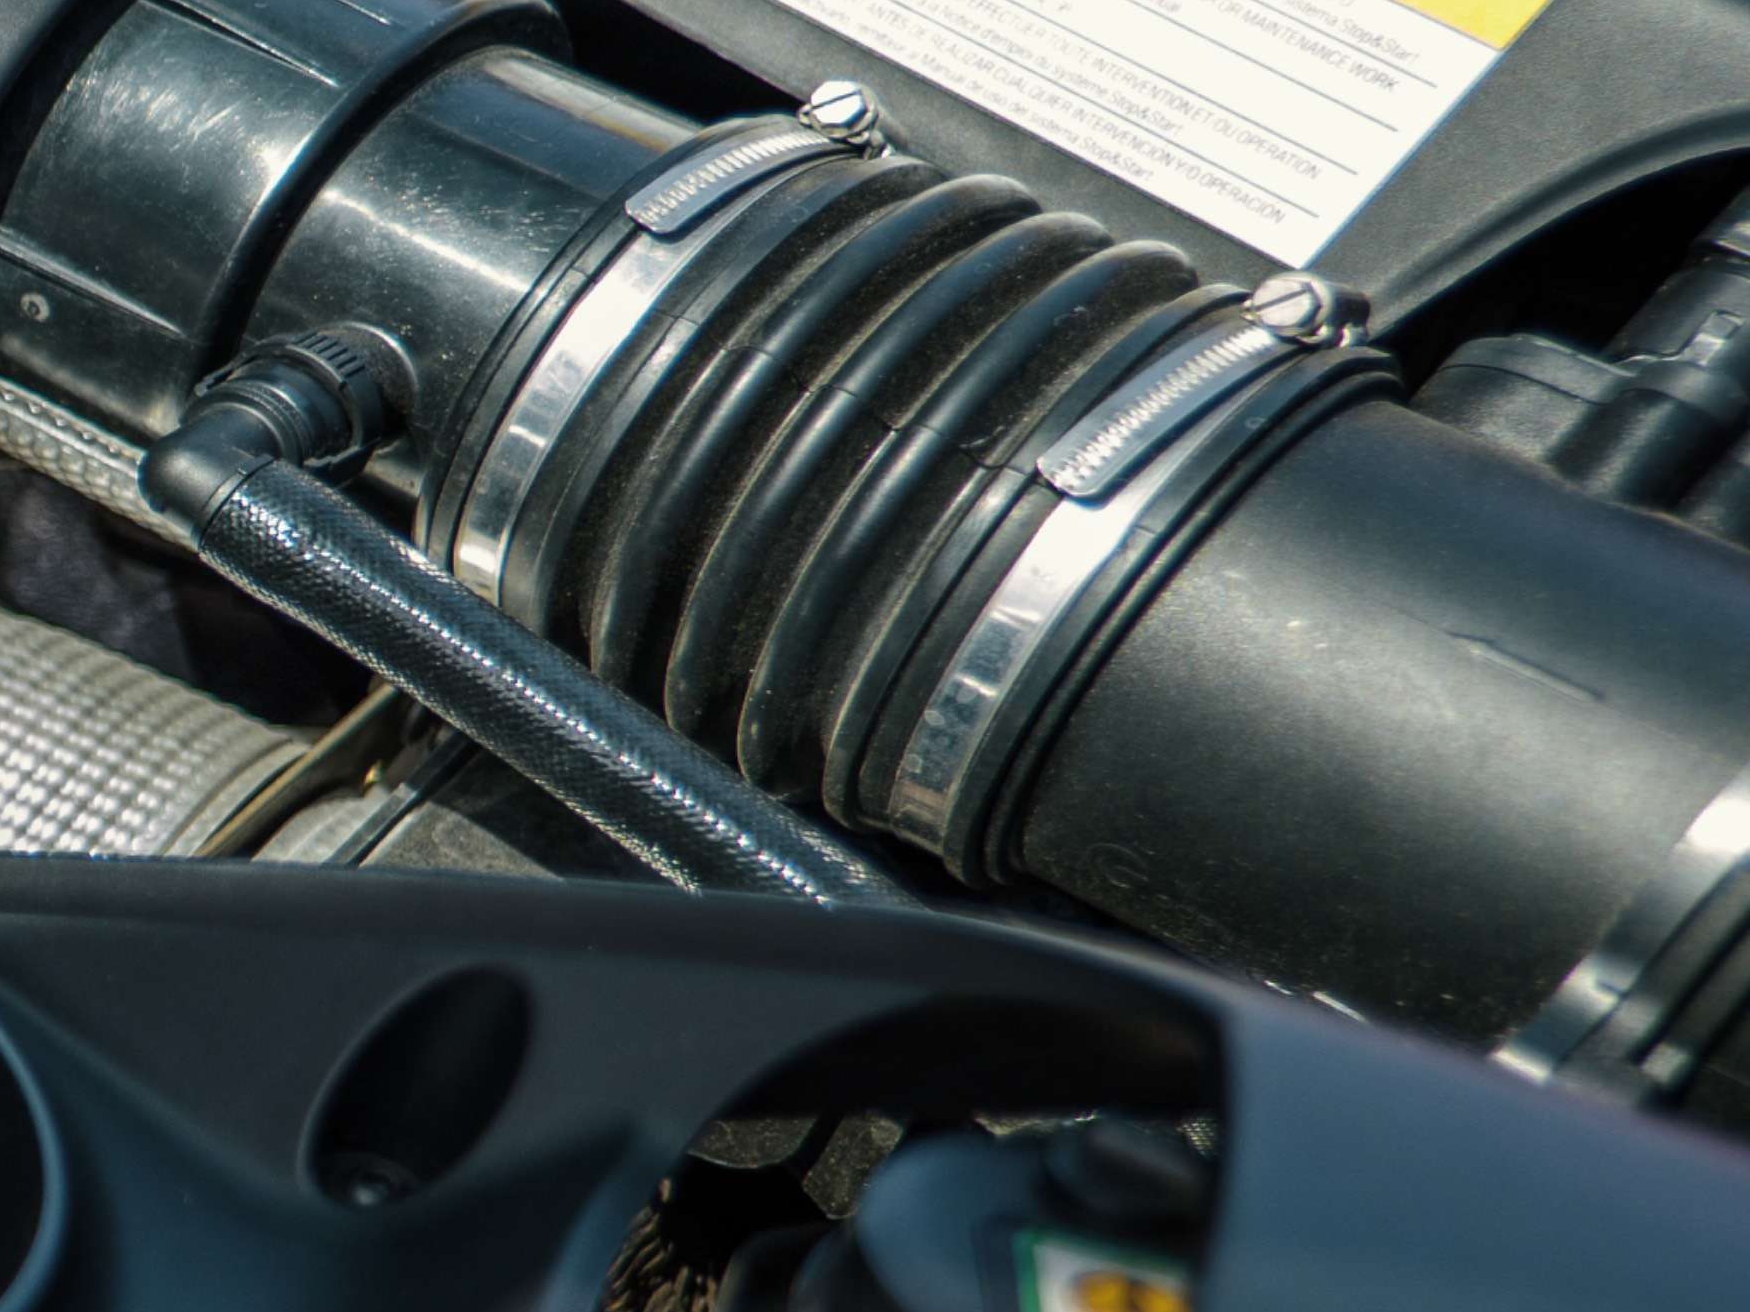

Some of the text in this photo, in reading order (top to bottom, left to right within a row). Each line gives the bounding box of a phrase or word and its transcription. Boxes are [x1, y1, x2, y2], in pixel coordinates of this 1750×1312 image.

[1238, 7, 1353, 69] MAINTENANCE
[1335, 17, 1423, 66] Stop&Start
[1088, 55, 1197, 116] INTERVENTION
